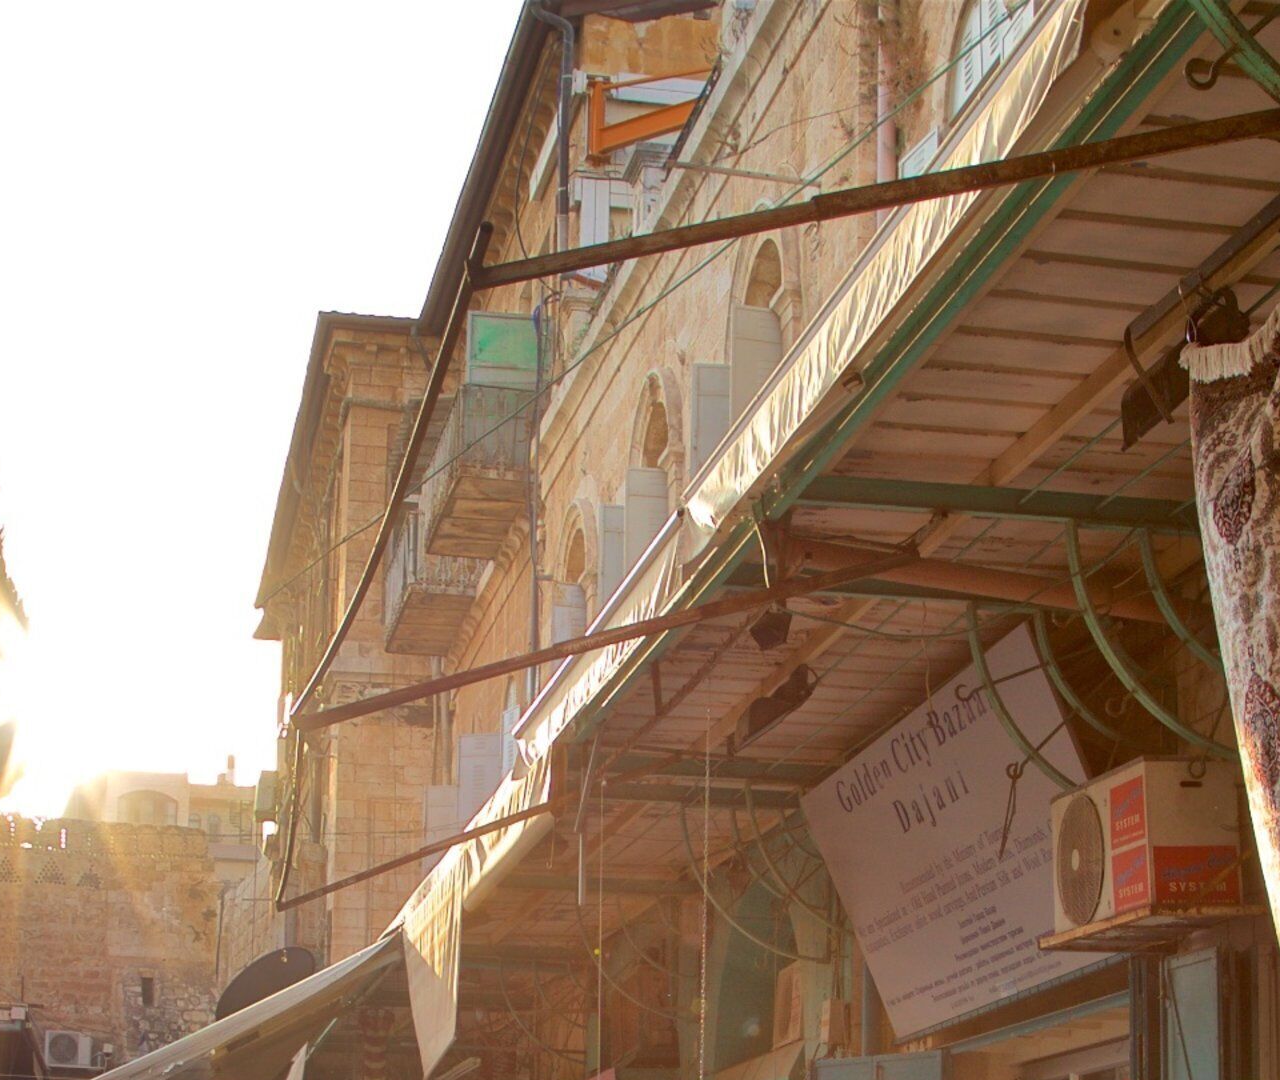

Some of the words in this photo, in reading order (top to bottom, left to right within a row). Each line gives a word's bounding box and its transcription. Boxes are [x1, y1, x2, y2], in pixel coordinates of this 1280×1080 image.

[836, 758, 893, 813] Golden
[890, 731, 932, 773] City
[927, 690, 994, 747] Bazaa
[892, 764, 971, 834] Dajani
